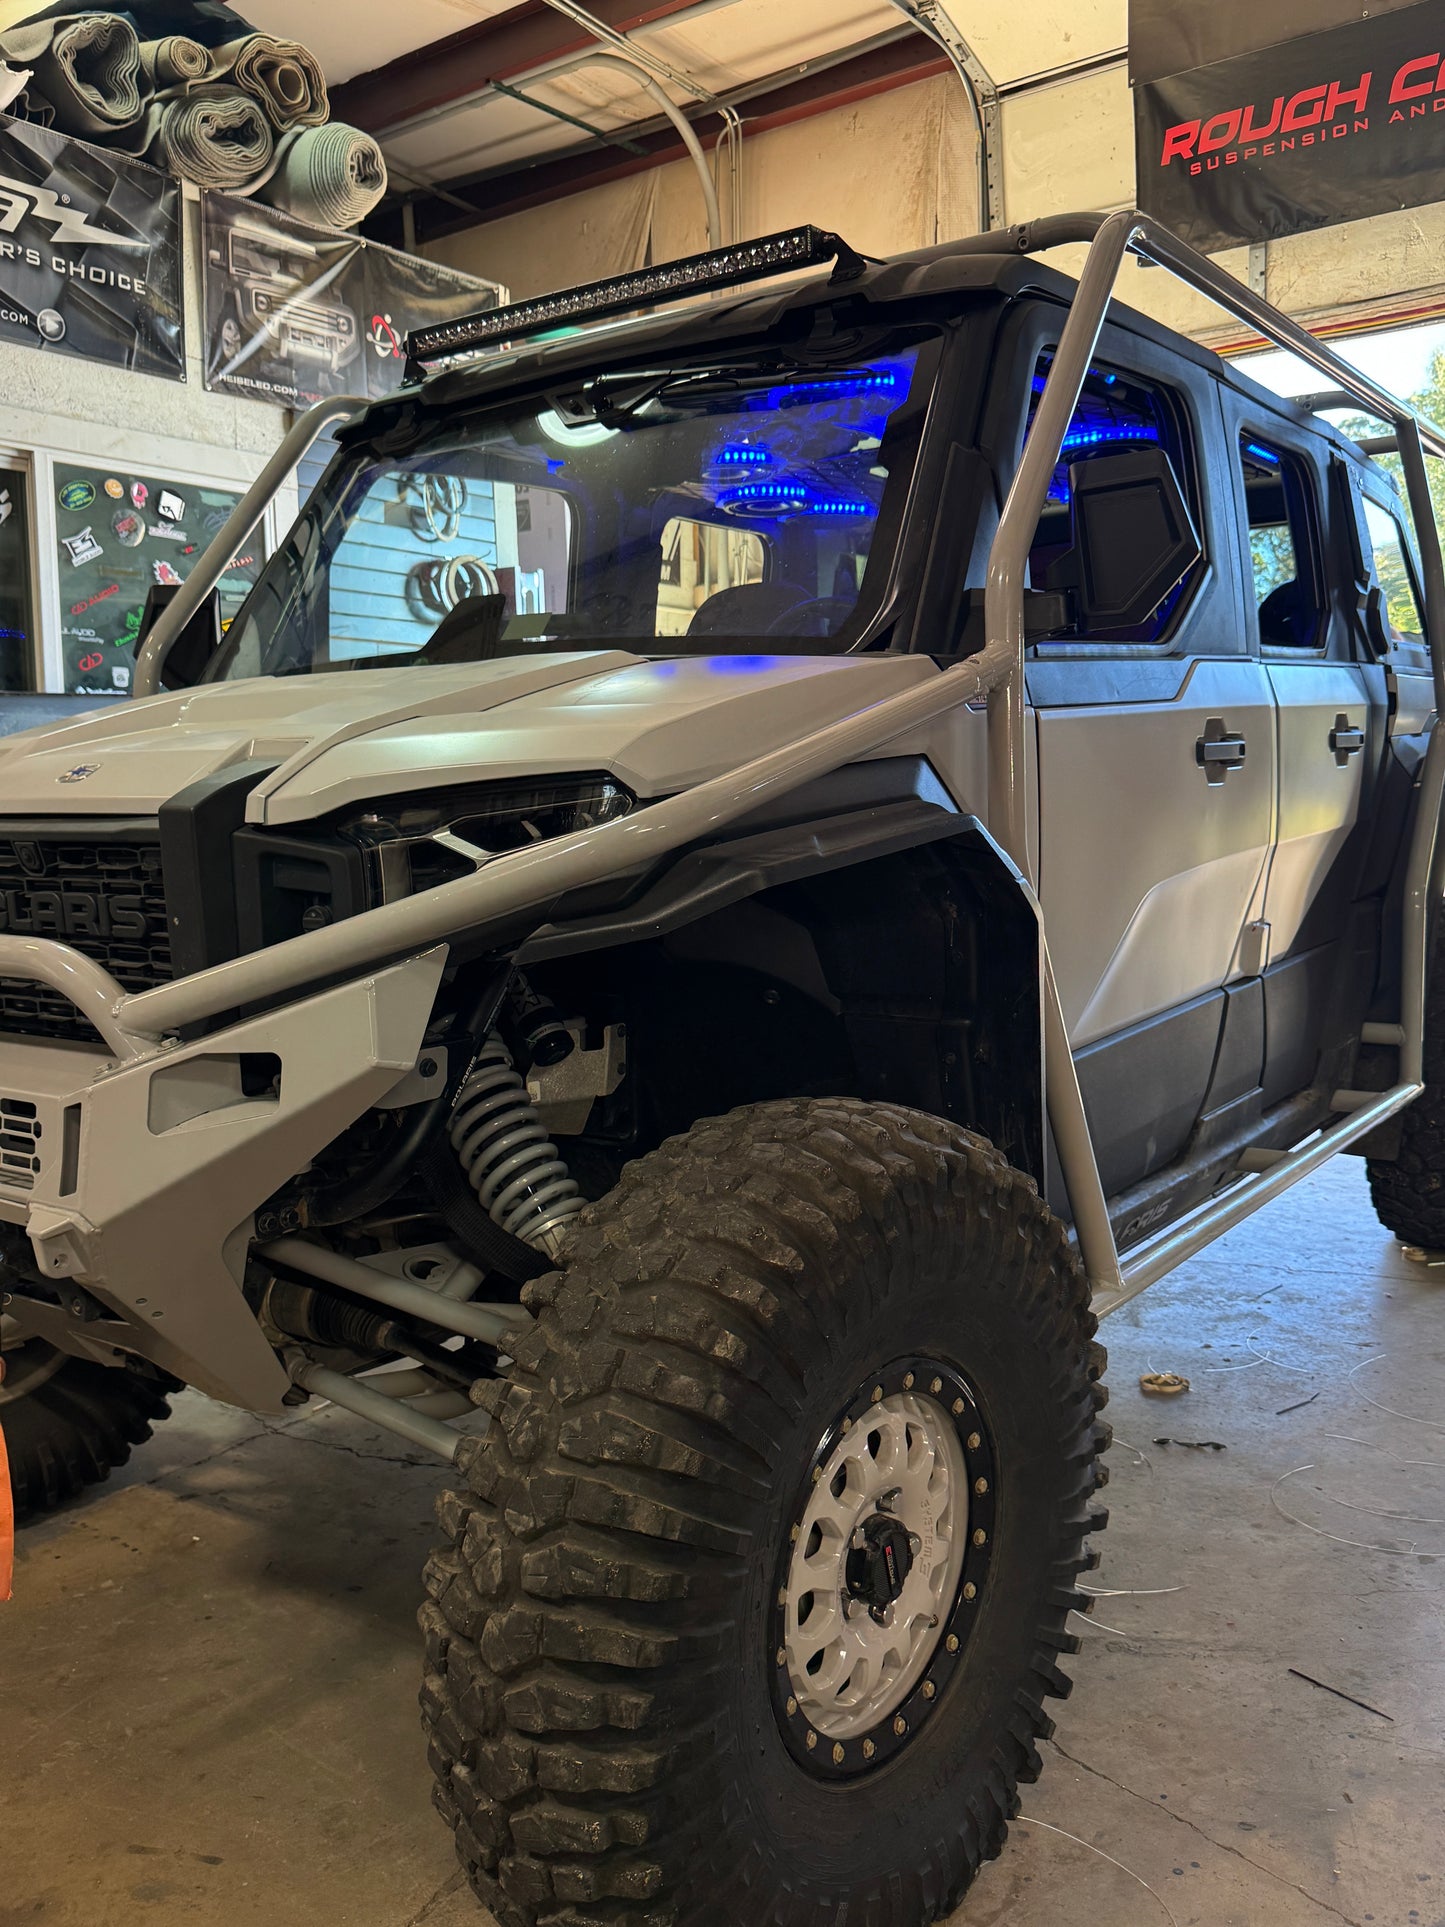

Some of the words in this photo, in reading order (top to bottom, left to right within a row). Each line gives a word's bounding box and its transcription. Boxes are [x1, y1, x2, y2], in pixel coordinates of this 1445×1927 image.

[1160, 72, 1372, 166] ROUGH
[1388, 52, 1445, 104] C
[1190, 117, 1370, 176] SUSPENSION
[1389, 98, 1445, 124] AND
[51, 256, 147, 295] CHOICE
[451, 1055, 477, 1108] POLARIS
